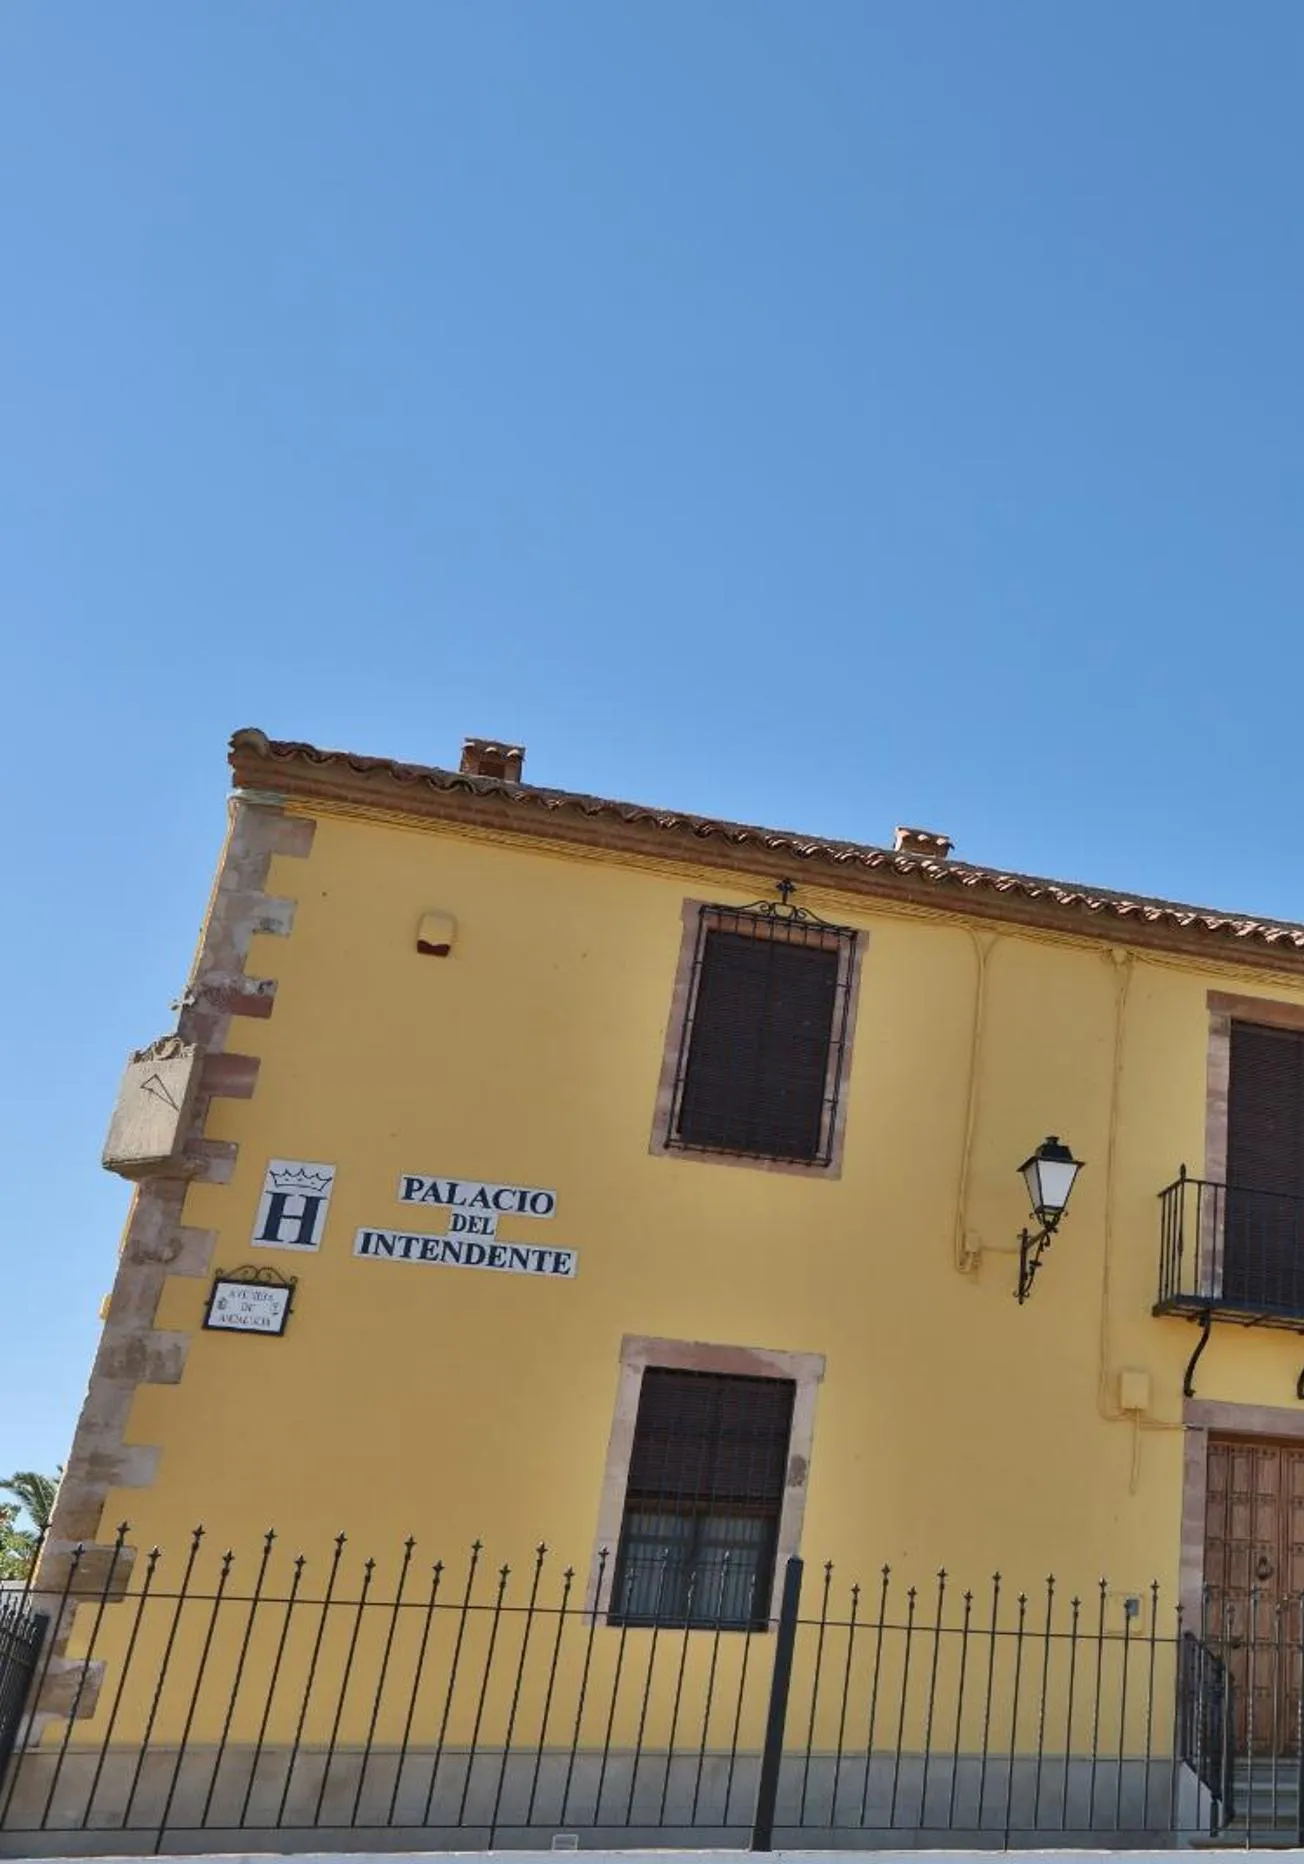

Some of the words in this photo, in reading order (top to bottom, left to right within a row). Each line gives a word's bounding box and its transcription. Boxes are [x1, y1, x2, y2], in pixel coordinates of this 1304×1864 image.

[401, 1176, 554, 1215] PALACIO
[253, 1190, 328, 1245] H
[450, 1213, 495, 1236] DEL
[358, 1231, 572, 1275] INTENDENTE
